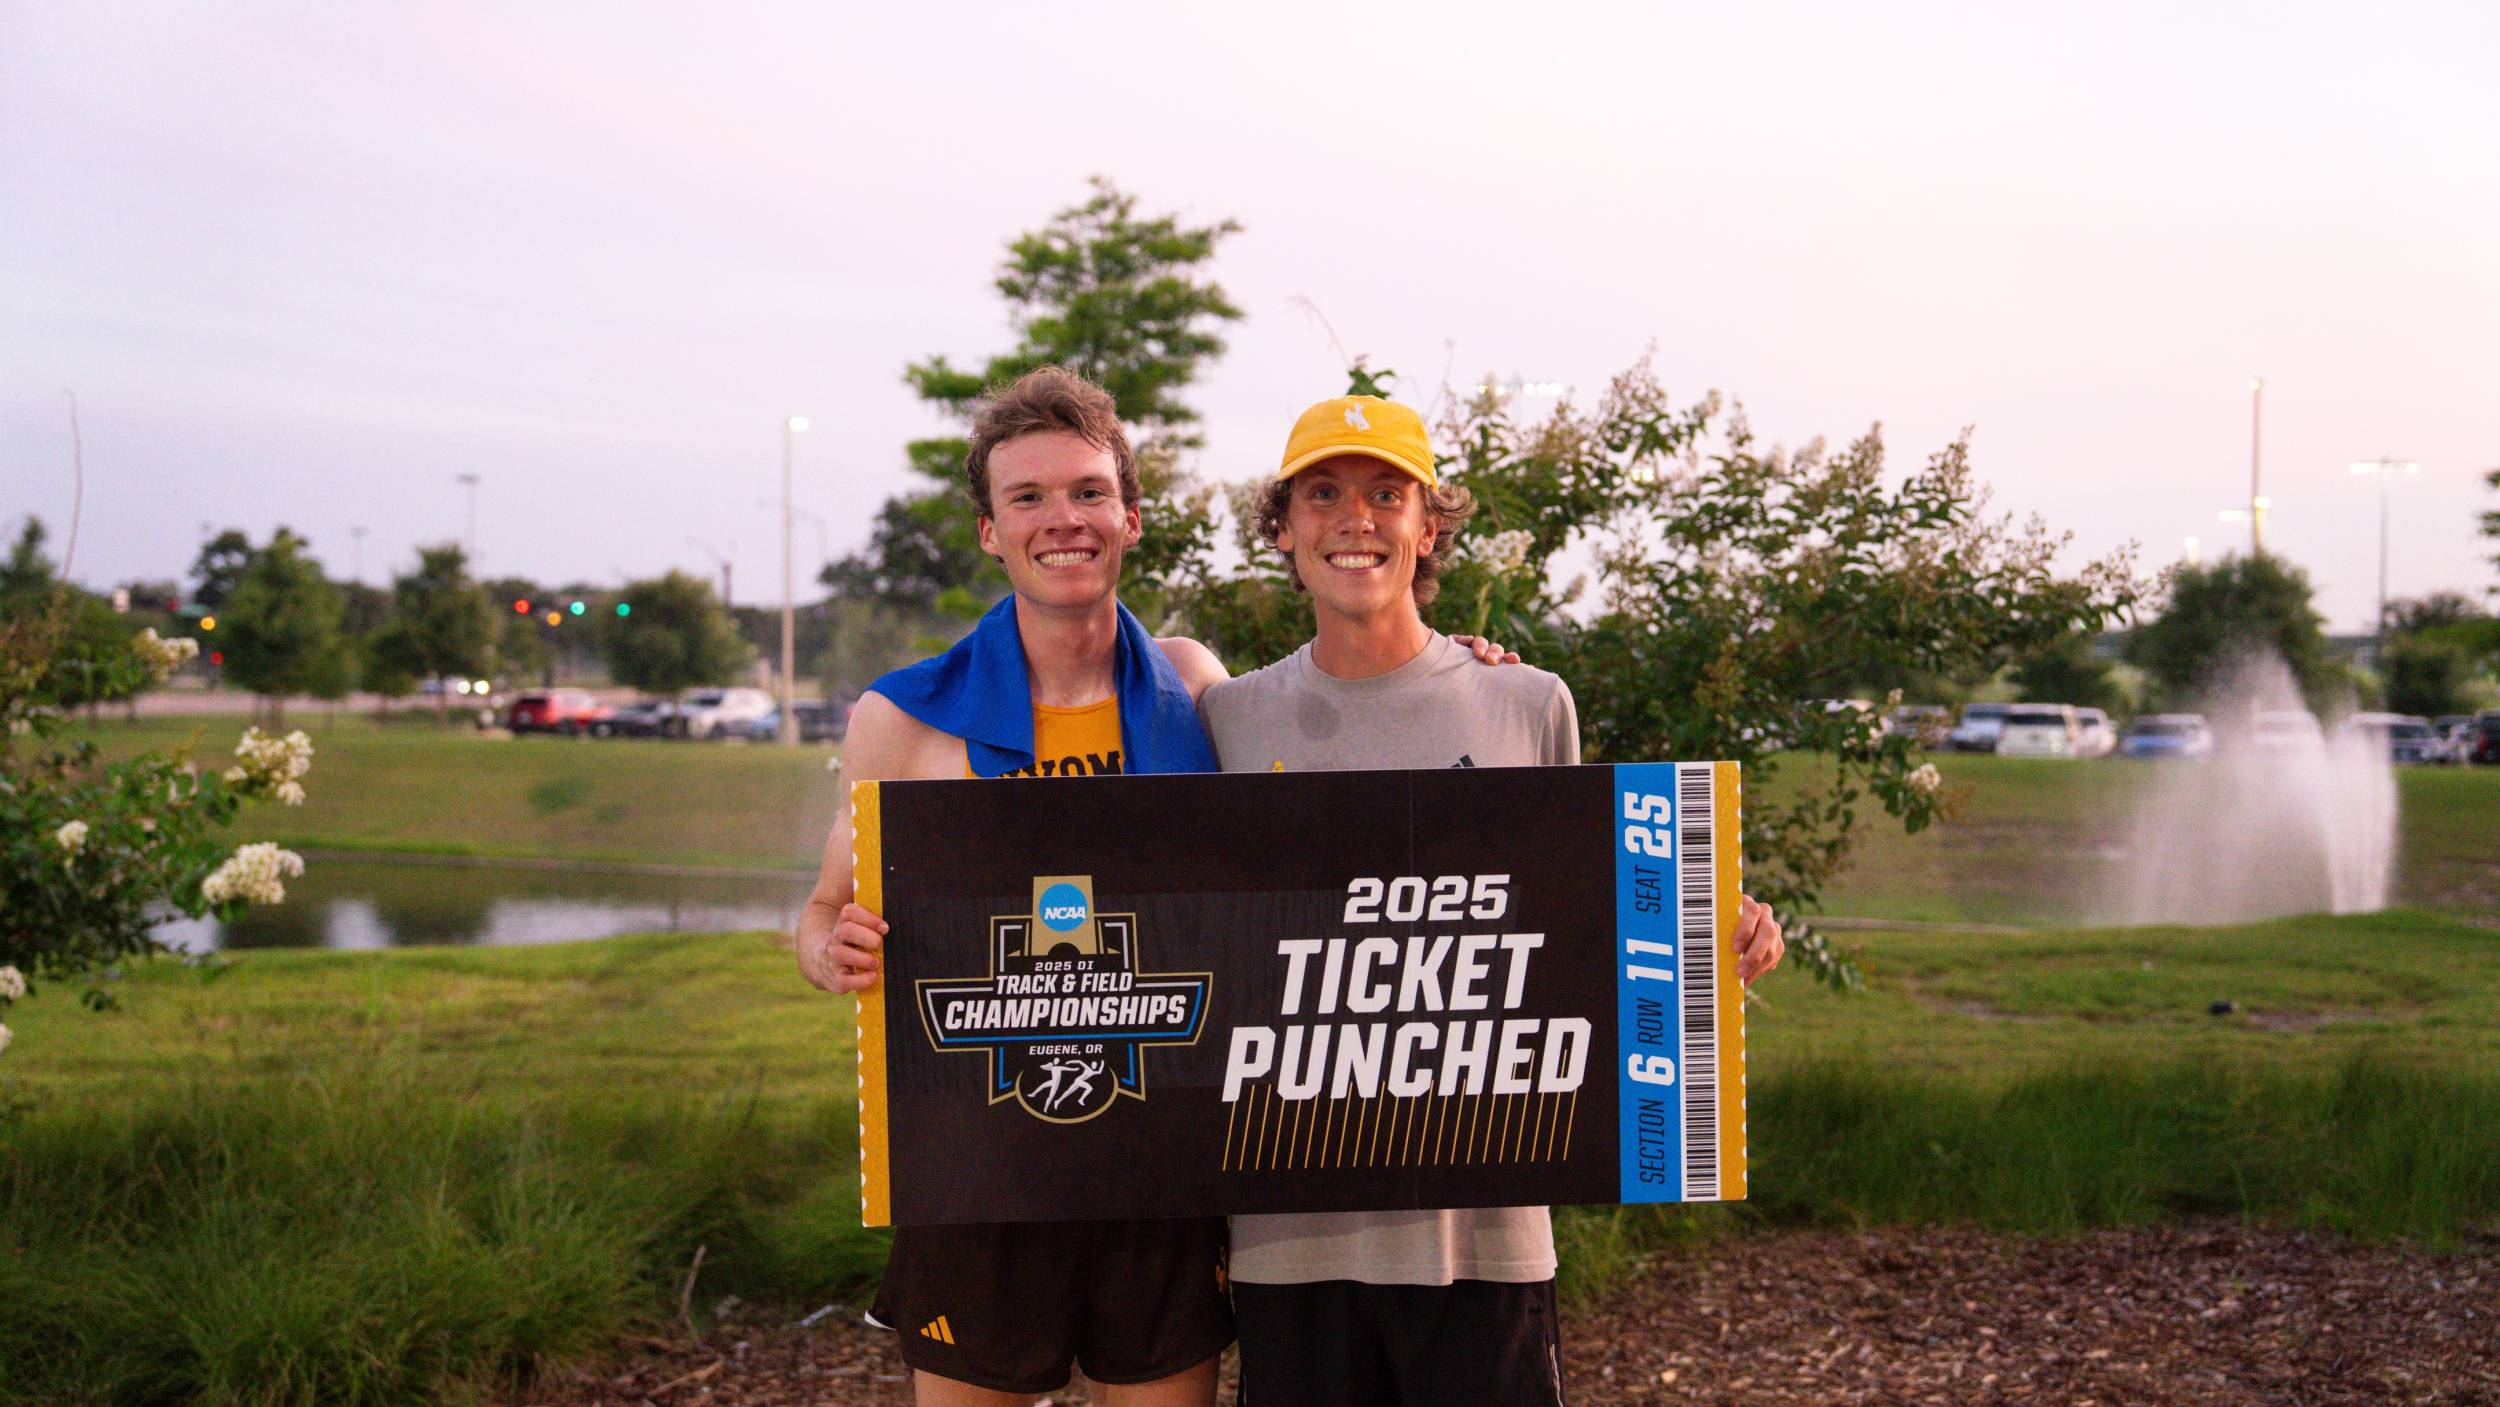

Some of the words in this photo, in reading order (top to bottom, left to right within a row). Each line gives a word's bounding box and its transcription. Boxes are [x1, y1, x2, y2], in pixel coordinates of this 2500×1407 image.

[1624, 791, 1672, 859] 25
[1343, 874, 1510, 923] 2025
[1635, 864, 1662, 914] SEAT
[1044, 906, 1086, 920] NCAA
[1034, 961, 1072, 972] 2025
[1077, 960, 1094, 970] DI
[1277, 933, 1545, 1015] TICKET
[1626, 938, 1674, 982] 11
[996, 974, 1058, 995] TRACK
[1061, 973, 1076, 993] &
[1080, 972, 1133, 992] FIELD
[944, 995, 1187, 1030] CHAMPIONSHIPS
[1637, 998, 1663, 1046] ROW
[1029, 1045, 1081, 1056] EUGENE,
[1085, 1044, 1103, 1054] OR
[1222, 1017, 1592, 1102] PUNCHED
[1628, 1053, 1675, 1086] 6
[1638, 1098, 1665, 1185] SECTION
